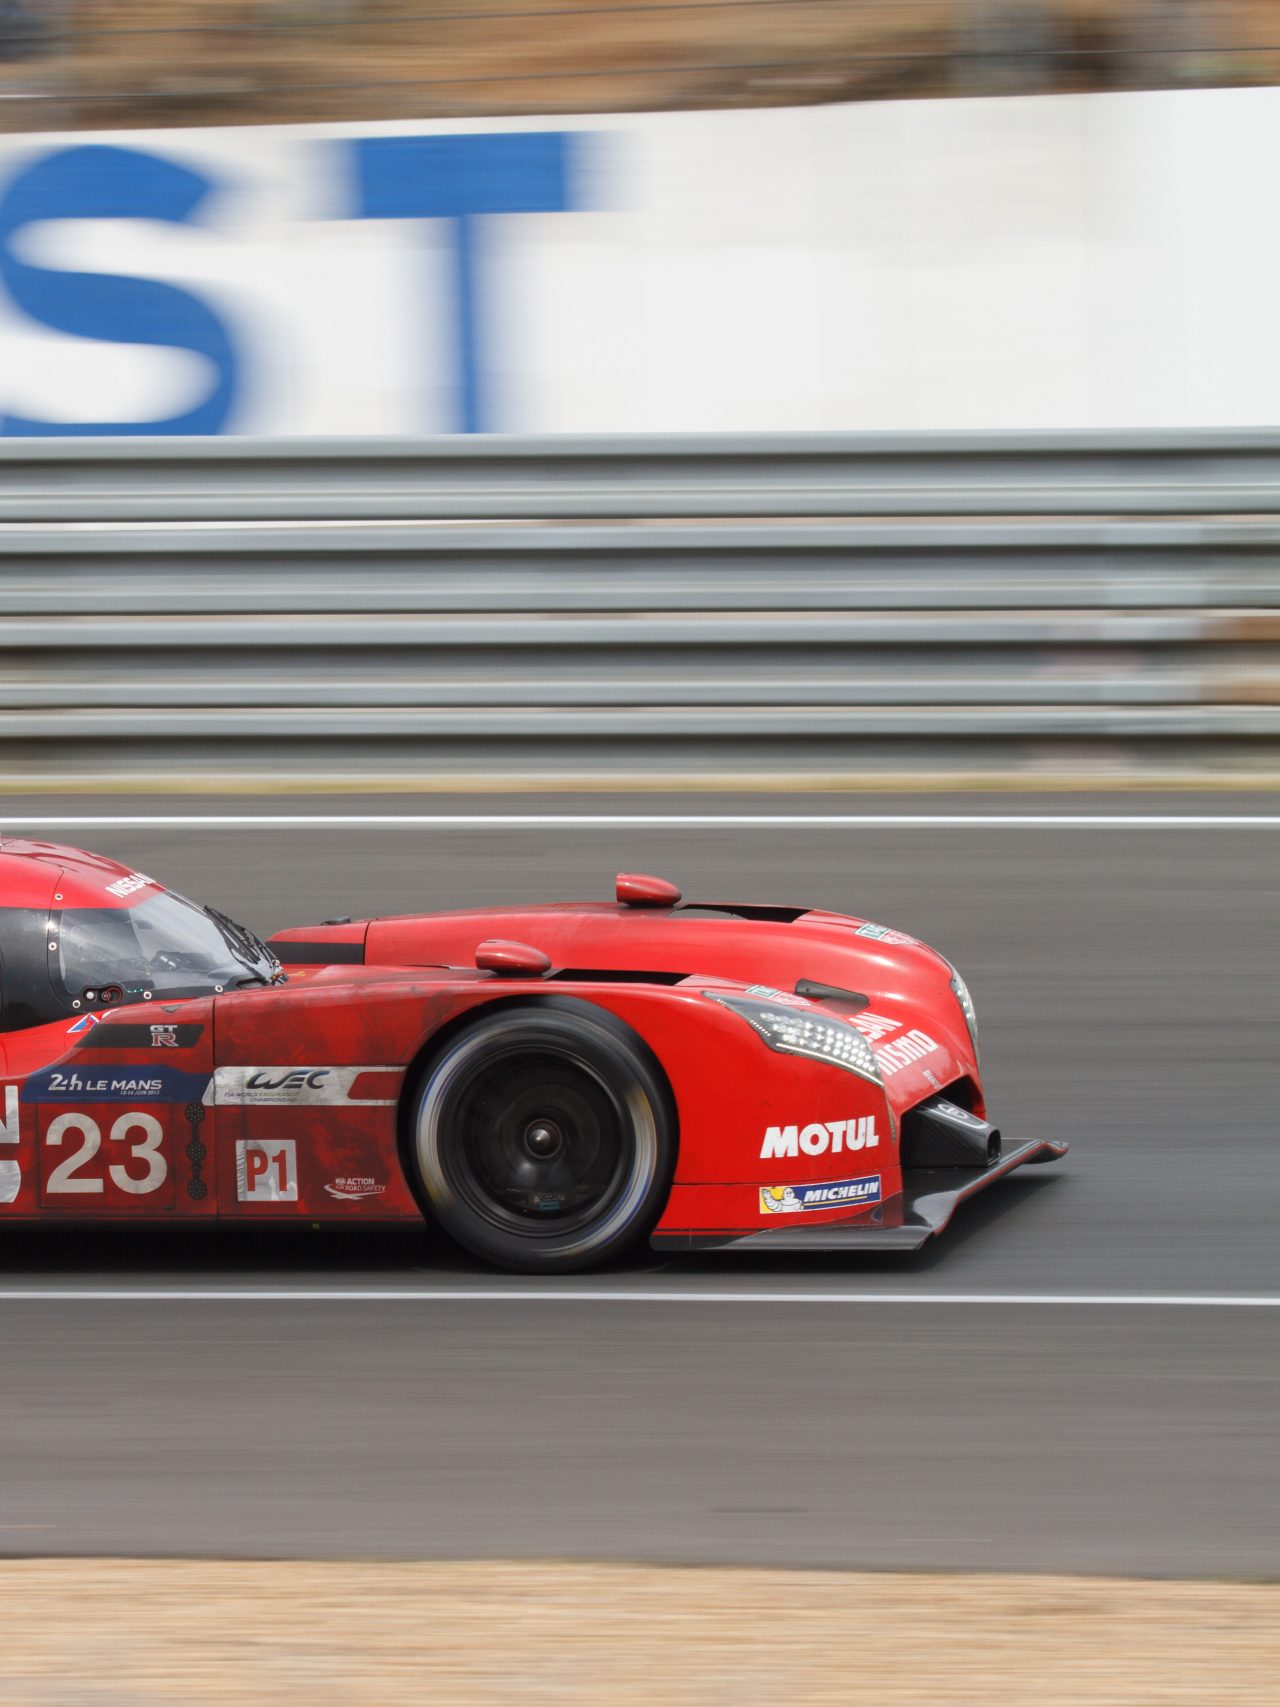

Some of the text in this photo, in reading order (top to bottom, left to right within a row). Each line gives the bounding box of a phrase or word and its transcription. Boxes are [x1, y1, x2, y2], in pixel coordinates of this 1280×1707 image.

[151, 1033, 179, 1047] R
[48, 1073, 162, 1091] 24h LE MANS
[246, 1069, 330, 1090] WEC
[760, 1115, 880, 1159] MOTUL
[45, 1112, 168, 1195] 23
[246, 1150, 288, 1192] P1
[347, 1177, 375, 1185] ACTION
[803, 1181, 880, 1203] MICHELIN
